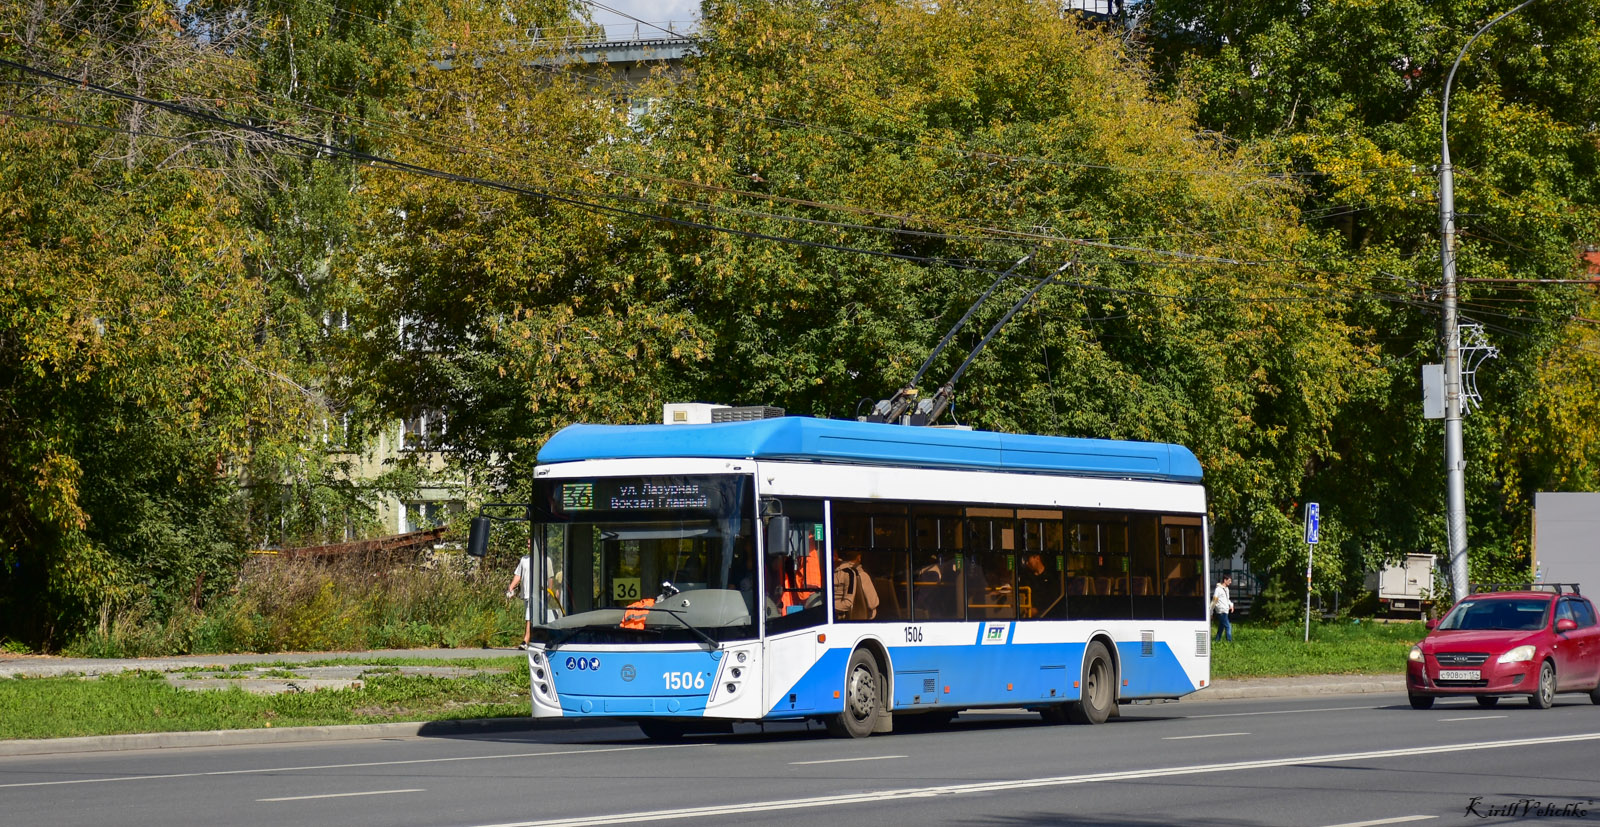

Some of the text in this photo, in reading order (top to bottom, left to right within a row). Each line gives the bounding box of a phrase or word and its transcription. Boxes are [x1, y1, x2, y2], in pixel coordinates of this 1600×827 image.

[563, 484, 592, 510] 36
[642, 483, 699, 496] Лазурная
[611, 494, 707, 509] Вокзал Главный
[617, 583, 638, 599] 36
[904, 626, 923, 643] 1506
[662, 671, 705, 690] 1506
